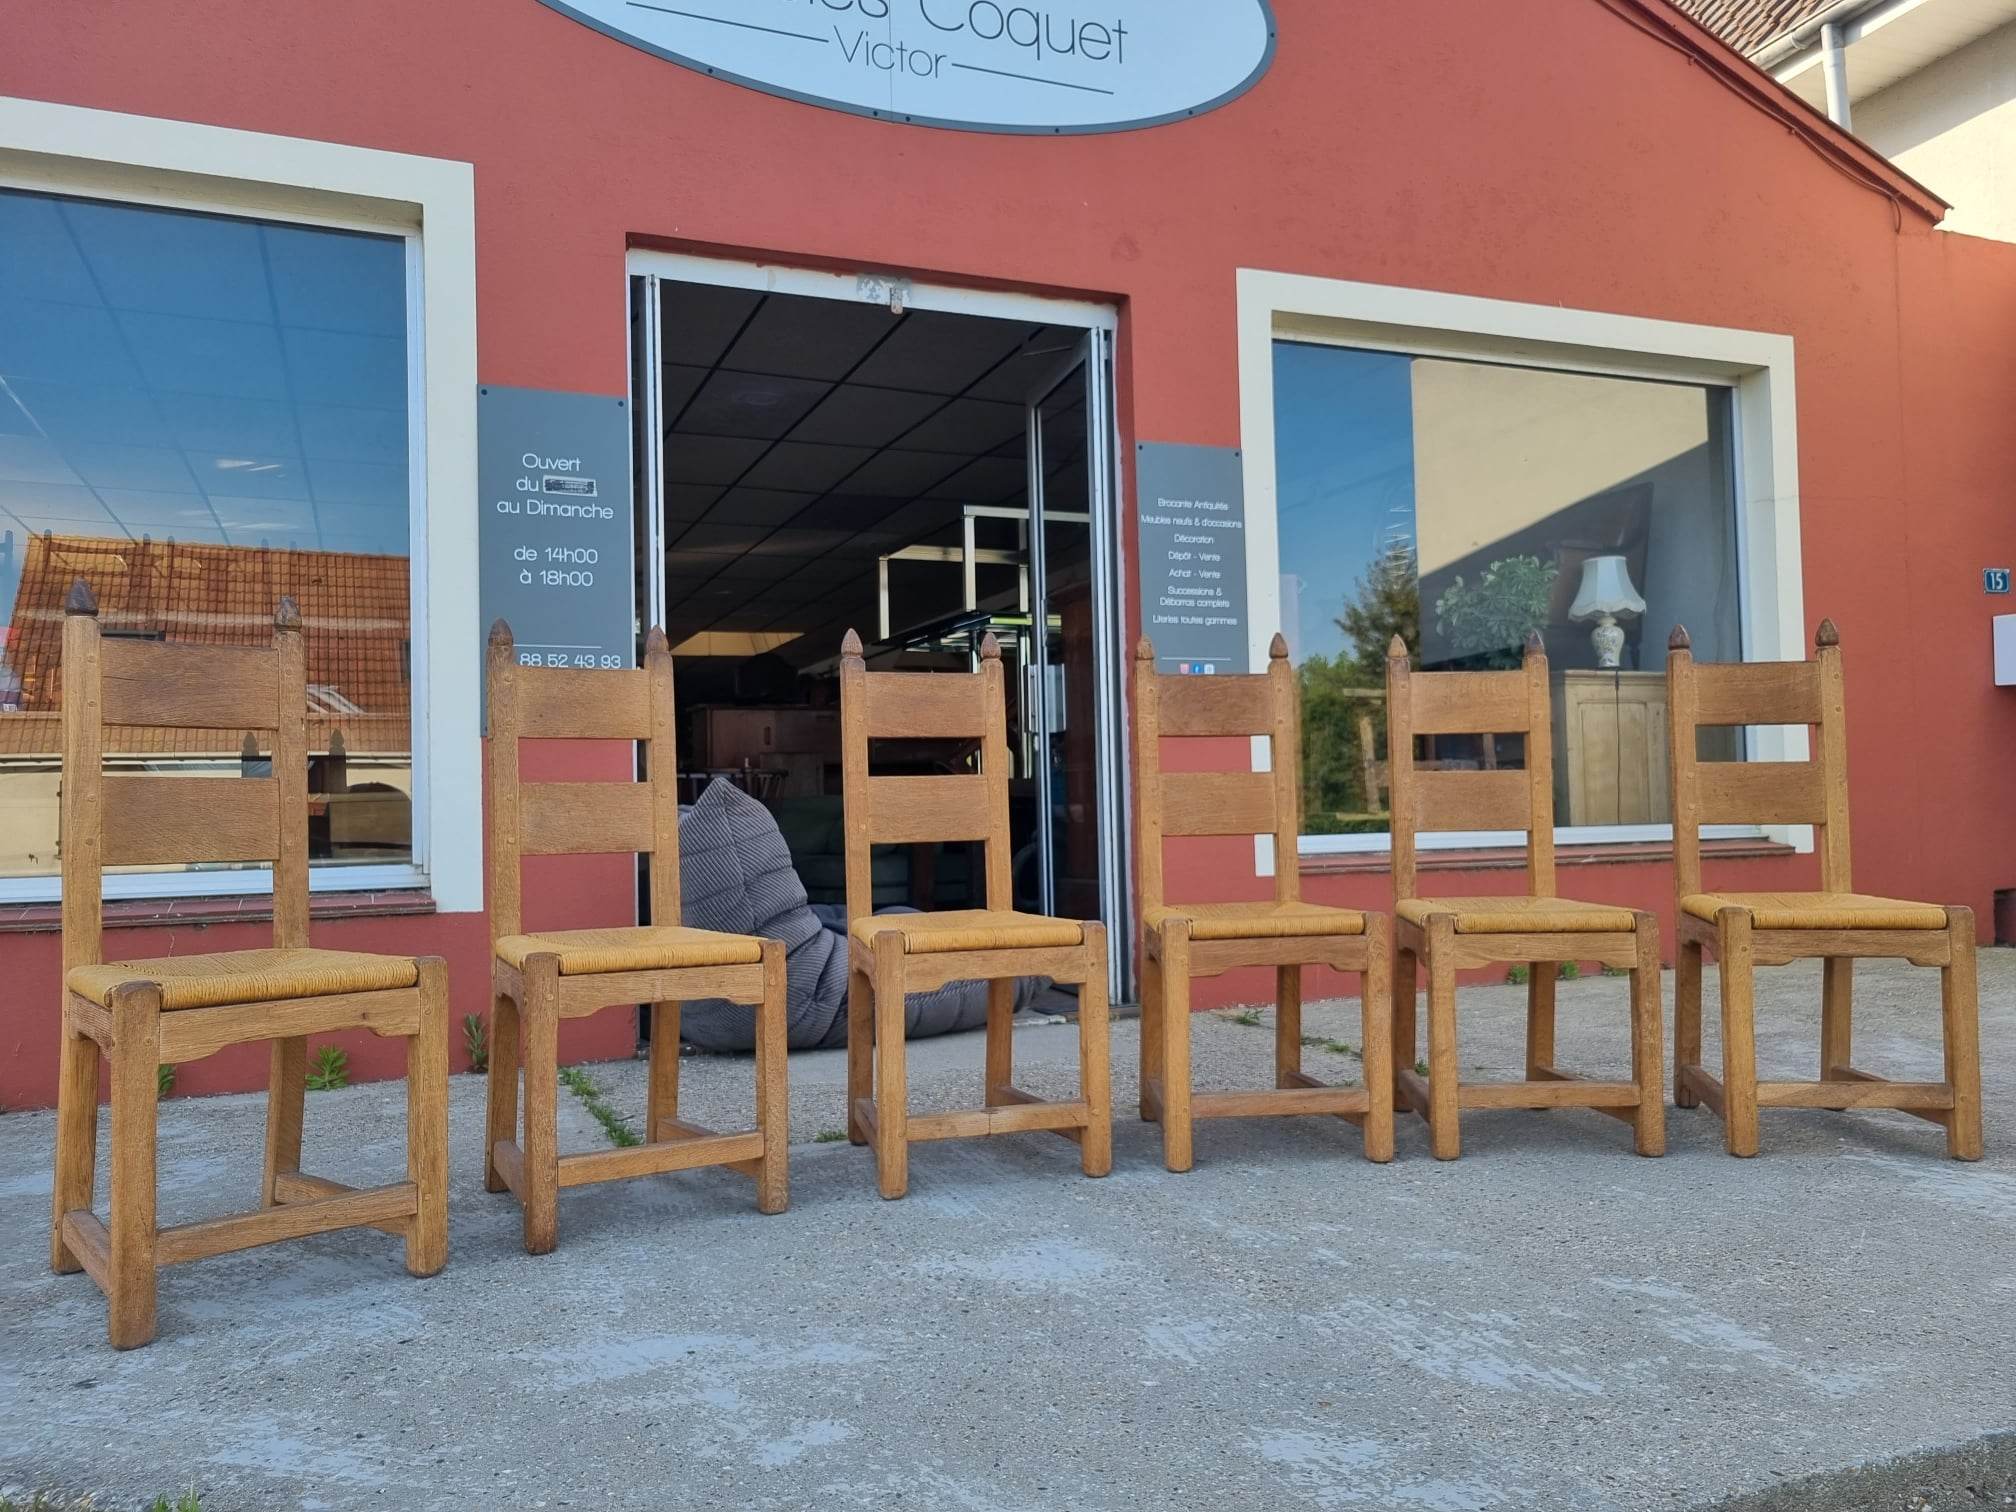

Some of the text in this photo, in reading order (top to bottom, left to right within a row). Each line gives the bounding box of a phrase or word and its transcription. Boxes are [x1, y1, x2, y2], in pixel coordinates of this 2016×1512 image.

[833, 24, 948, 79] Victor
[522, 453, 582, 472] Ouvert
[516, 476, 539, 492] du
[496, 499, 614, 520] au Dimanche
[1157, 497, 1229, 511] Brocante Antiquités
[1141, 514, 1171, 525] Meubles
[1172, 516, 1193, 526] neufs
[1173, 533, 1214, 545] Décoration
[513, 546, 599, 565] de 14h00
[1198, 553, 1221, 562] Vente
[519, 569, 594, 587] à 18h00
[1168, 568, 1192, 578] Achat
[1198, 569, 1221, 579] Vente
[1990, 572, 2003, 590] 15
[1167, 585, 1214, 596] Successions
[1180, 615, 1204, 625] toutes
[1204, 617, 1238, 627] gammes
[520, 653, 622, 669] 88 52 43 93
